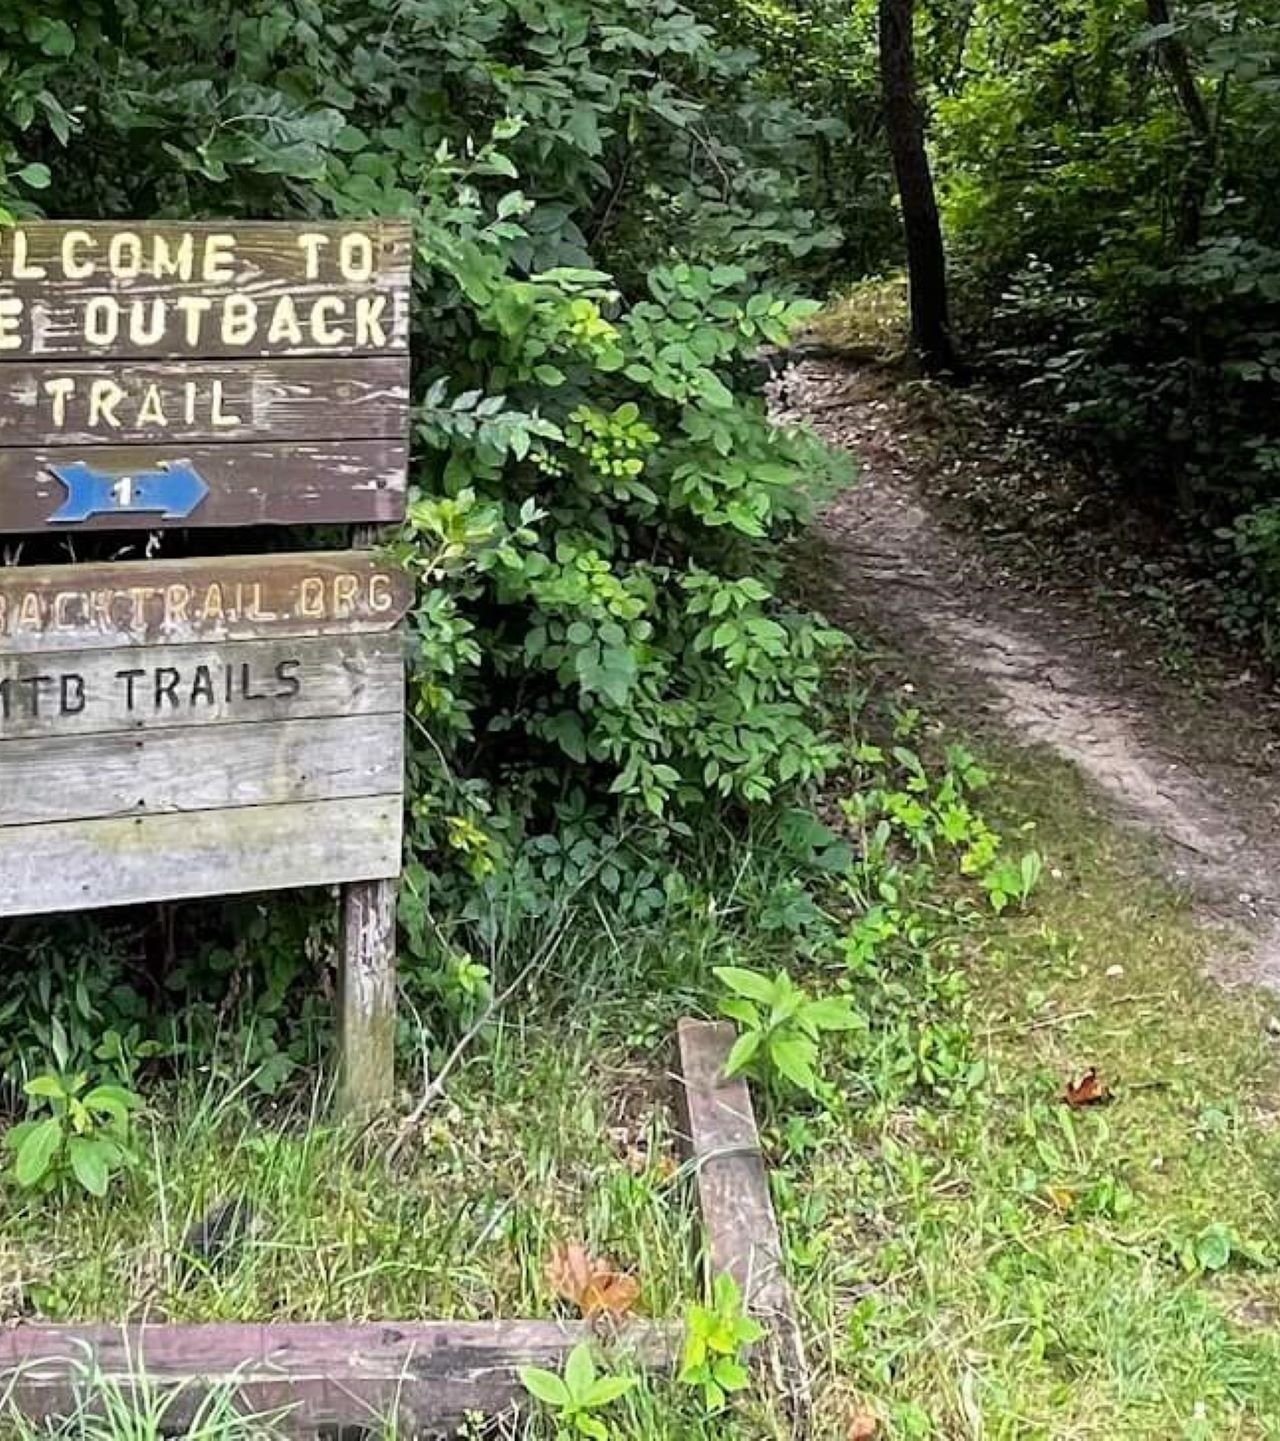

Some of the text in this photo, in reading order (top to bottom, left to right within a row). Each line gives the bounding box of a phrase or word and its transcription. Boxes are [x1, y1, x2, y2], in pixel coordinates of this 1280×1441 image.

[297, 233, 374, 280] TO
[84, 295, 387, 347] OUTBACK
[44, 377, 241, 428] TRAIL
[112, 477, 131, 505] 1
[116, 660, 303, 711] TRAILS
